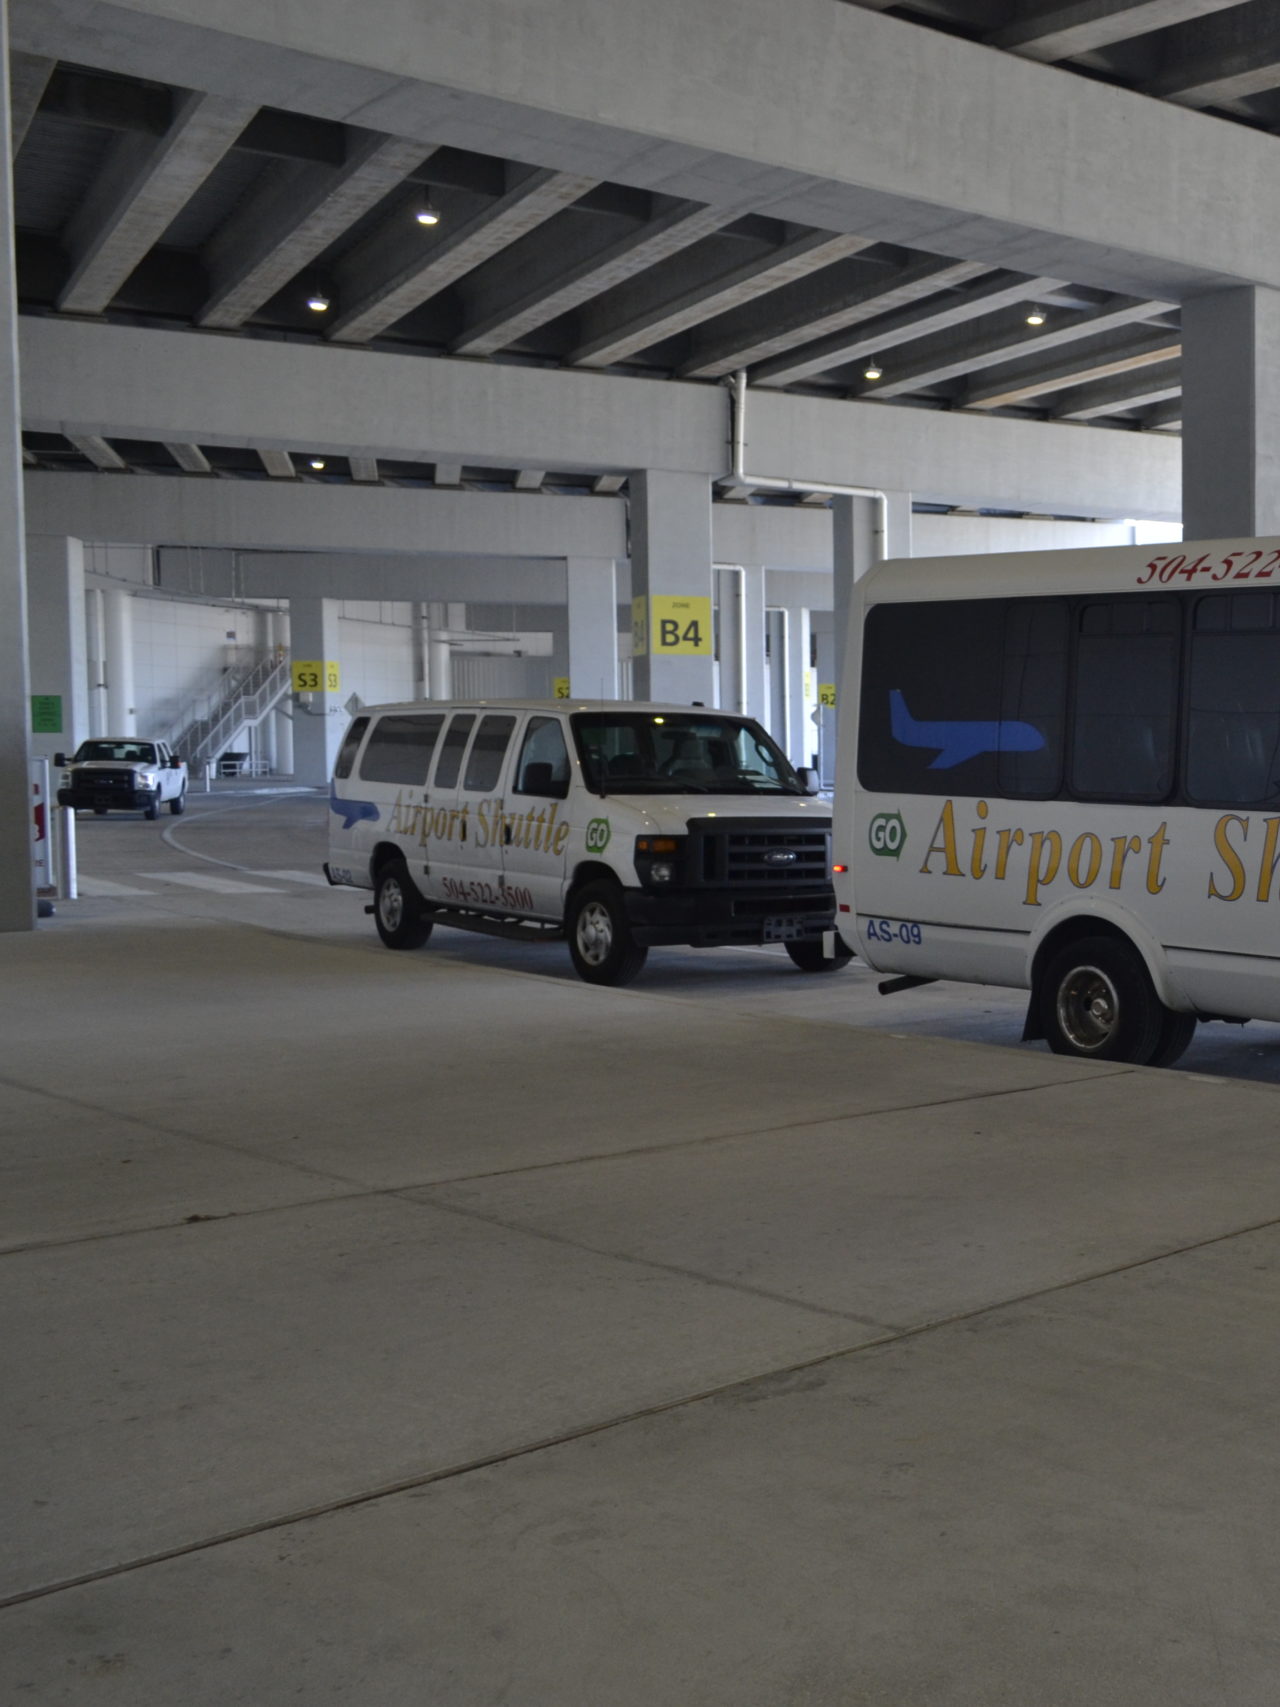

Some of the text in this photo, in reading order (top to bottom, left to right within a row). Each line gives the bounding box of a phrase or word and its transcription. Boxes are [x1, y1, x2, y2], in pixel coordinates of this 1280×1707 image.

[660, 618, 703, 648] B4
[297, 672, 319, 688] S3
[386, 789, 570, 857] Airport Shuttle
[586, 821, 609, 847] GO
[870, 817, 901, 851] GO
[919, 799, 1170, 906] Airport
[441, 876, 535, 911] 504-522-3500
[866, 919, 923, 945] AS-09
